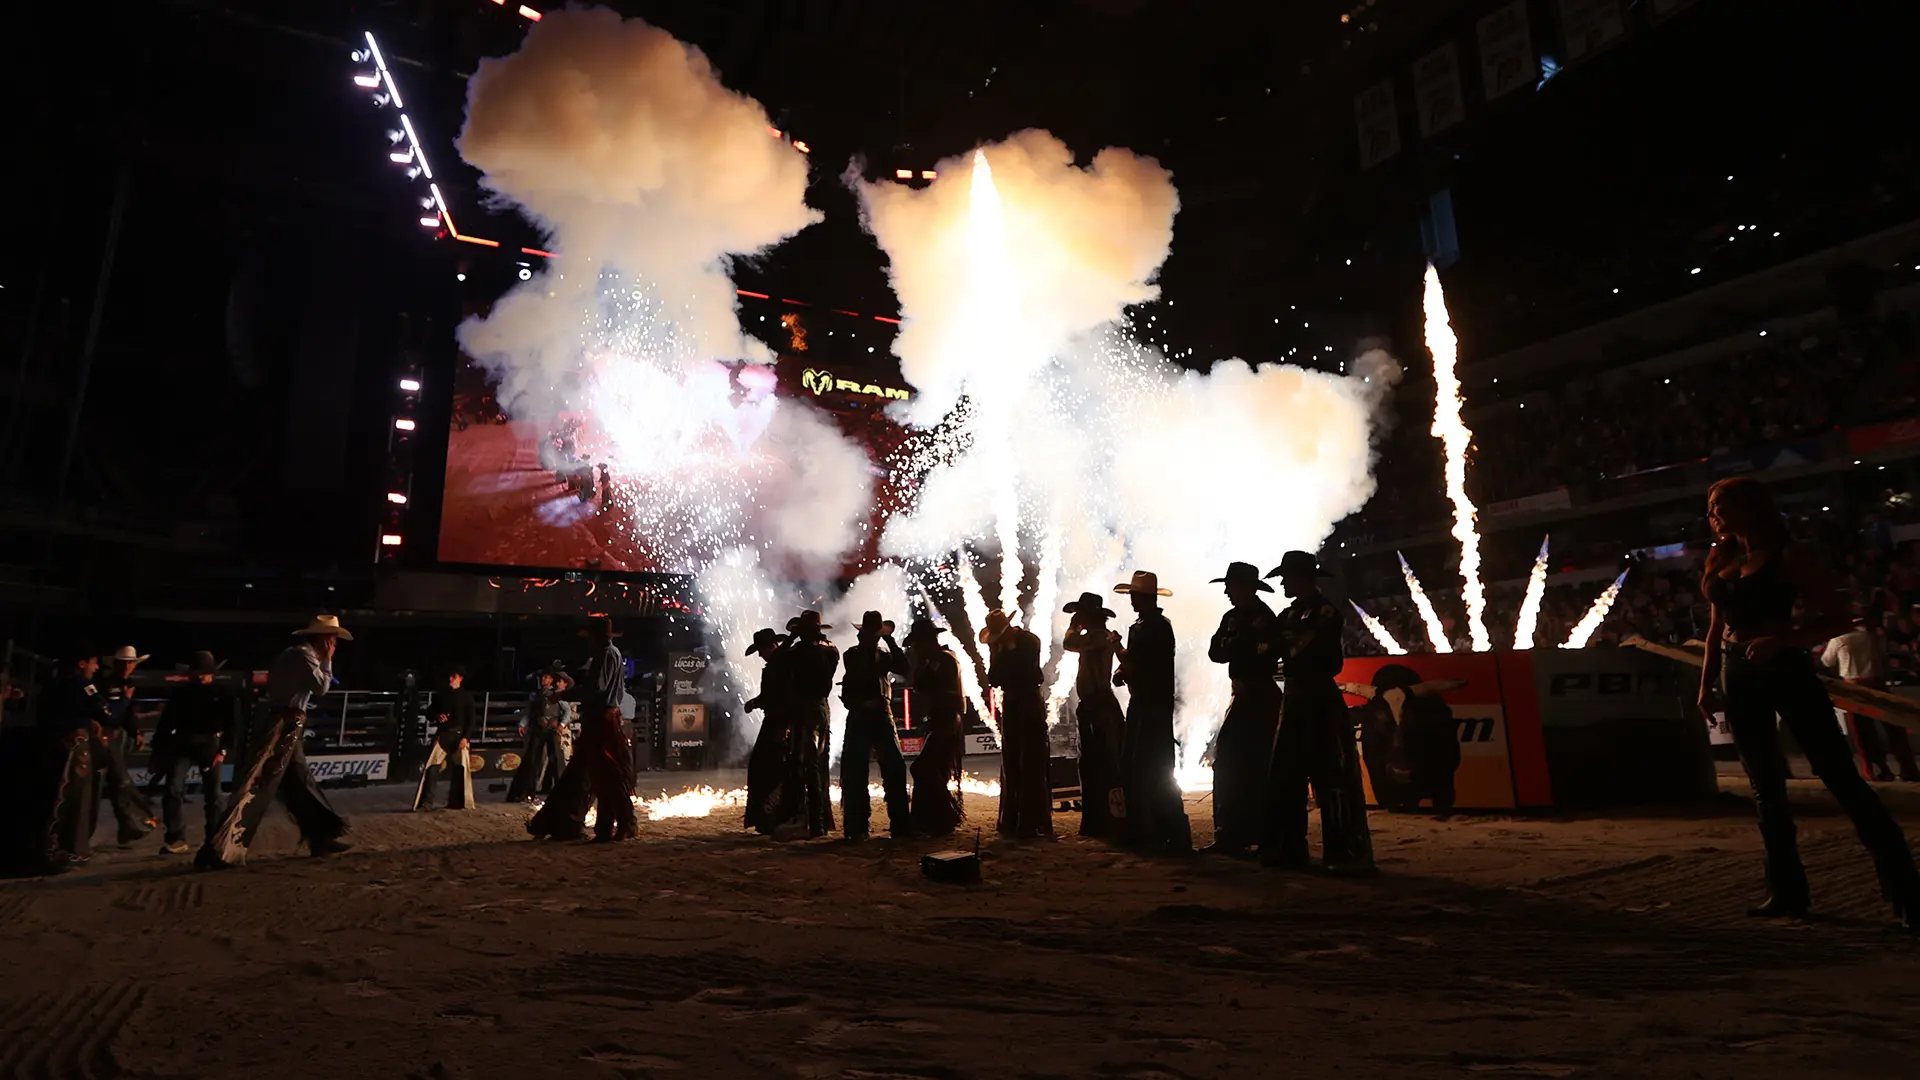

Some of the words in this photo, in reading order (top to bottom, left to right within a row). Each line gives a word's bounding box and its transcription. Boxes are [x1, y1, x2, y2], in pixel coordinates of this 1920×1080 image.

[835, 378, 910, 401] RAM
[674, 659, 695, 668] LUCAS
[695, 660, 706, 668] OIL
[671, 739, 703, 748] Priefert
